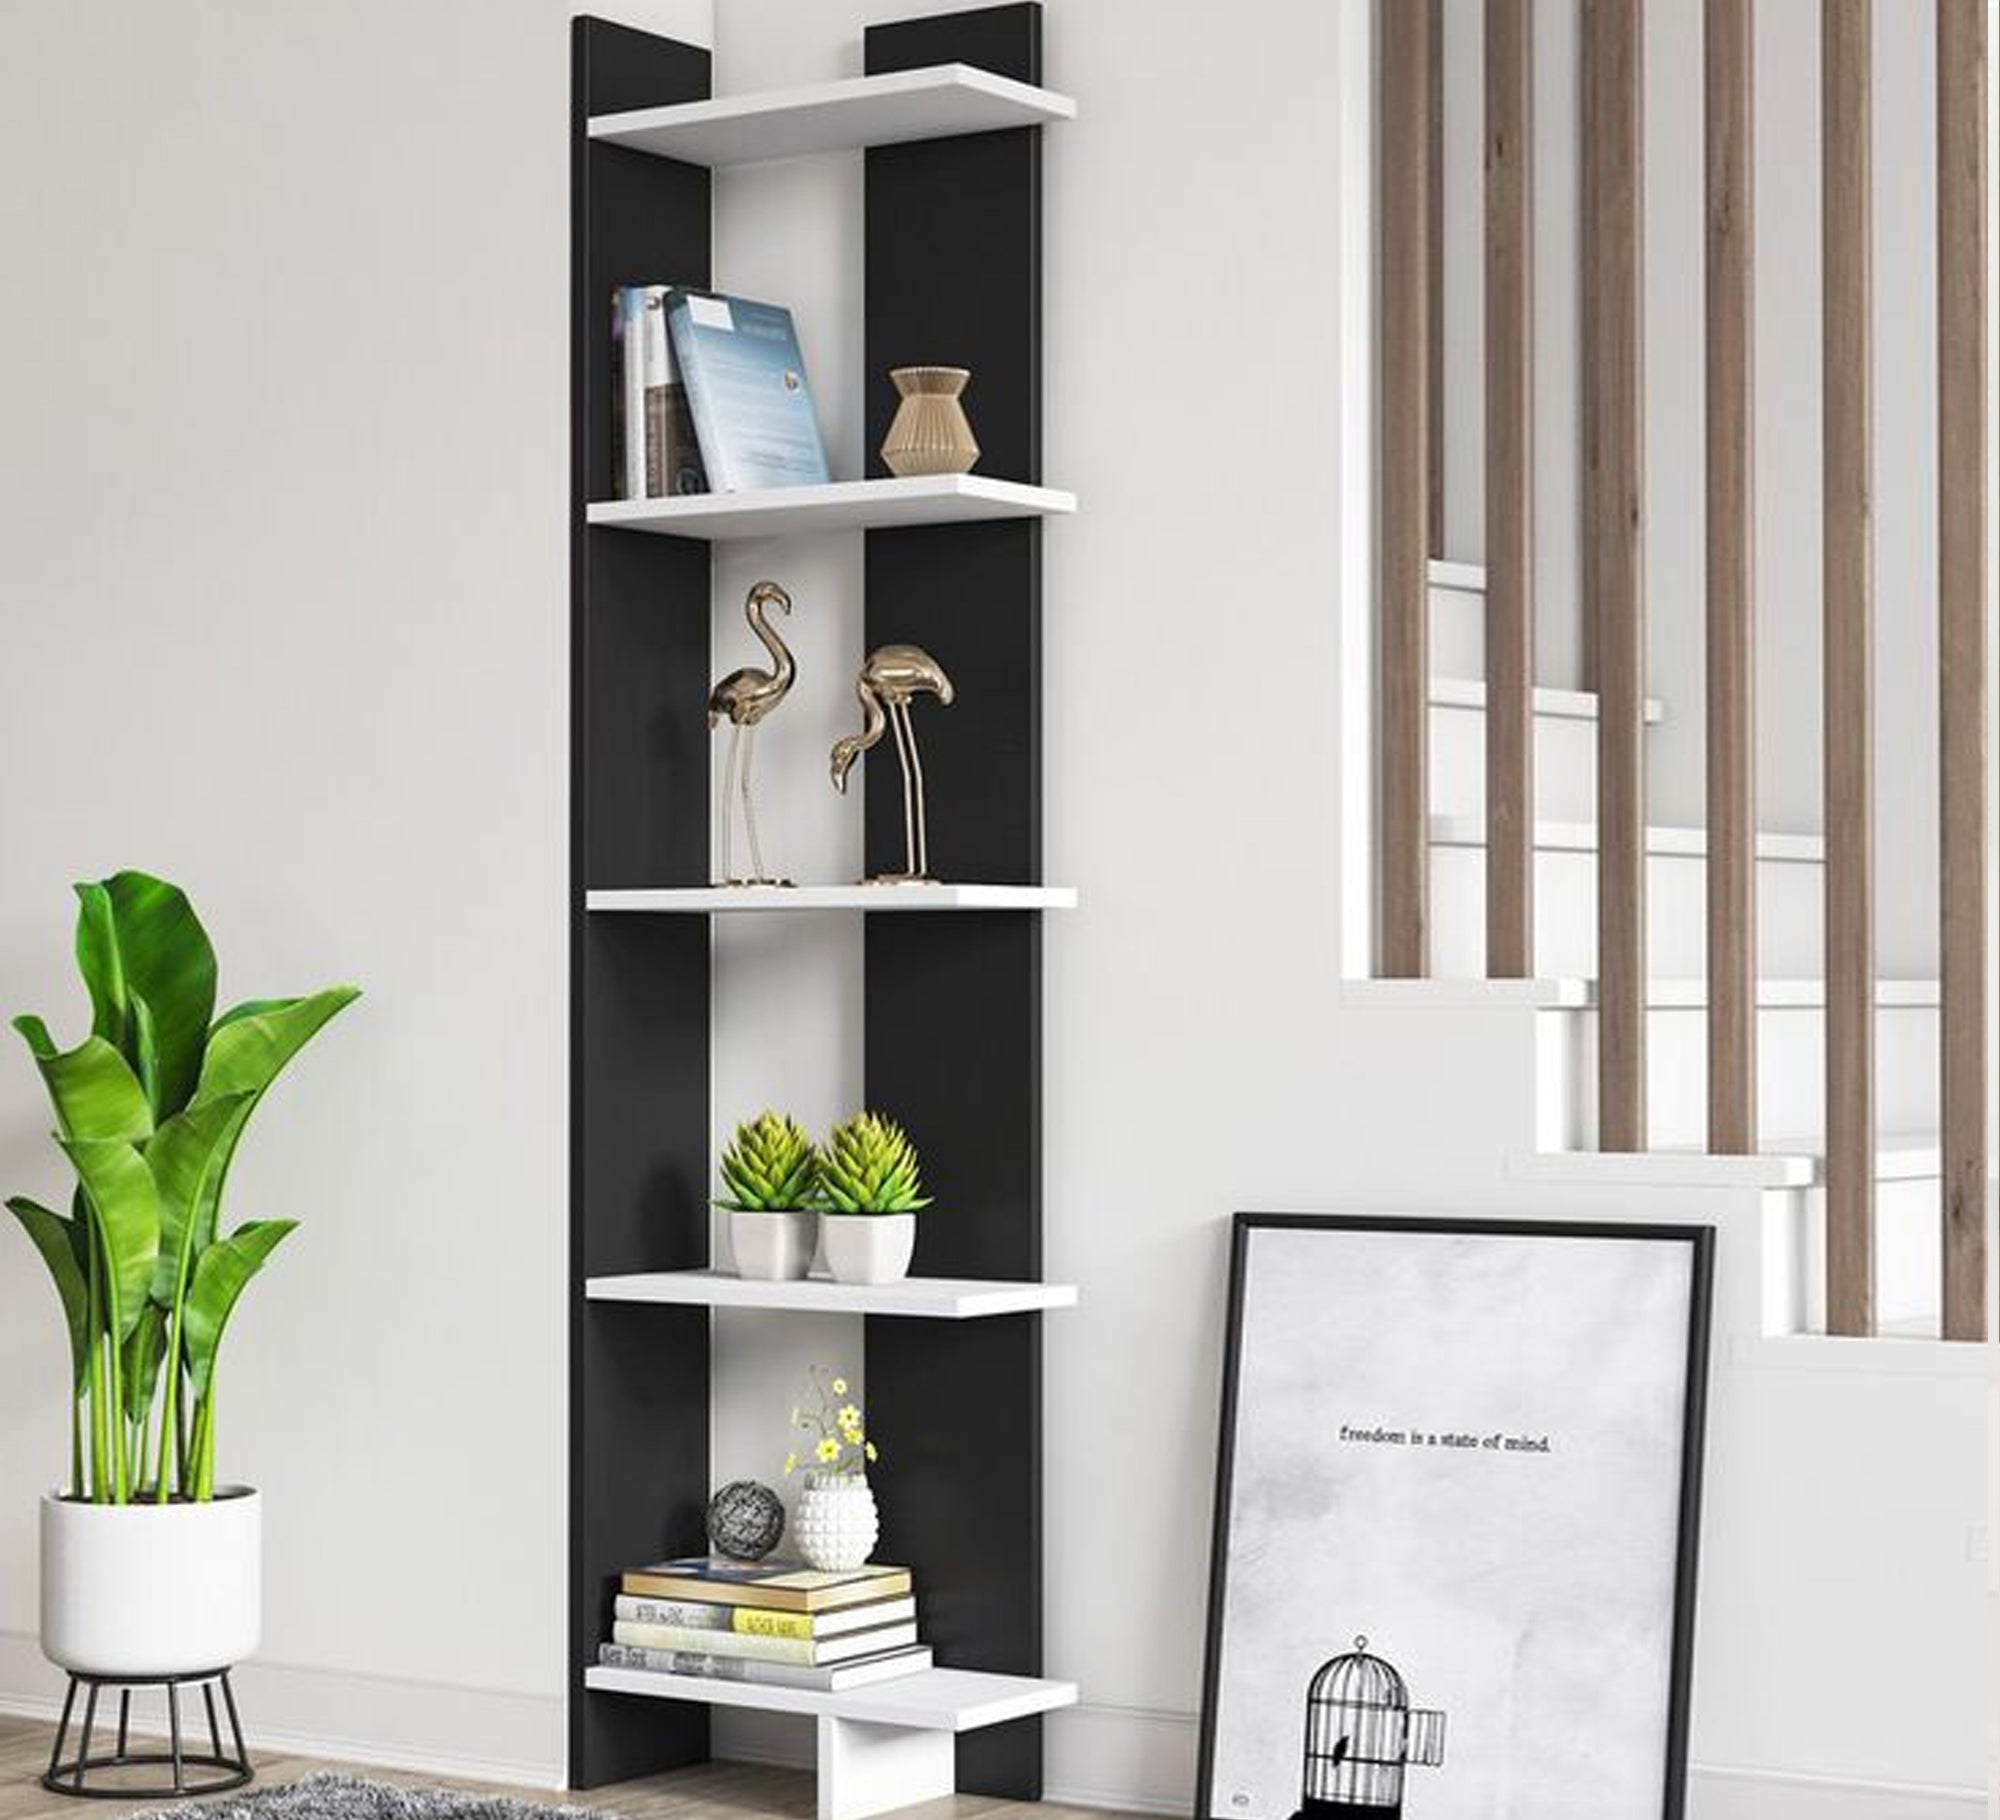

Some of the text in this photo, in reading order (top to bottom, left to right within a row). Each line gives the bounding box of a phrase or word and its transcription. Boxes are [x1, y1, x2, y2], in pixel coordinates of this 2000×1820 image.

[1339, 1425, 1551, 1453] freedom is a state of mind.
